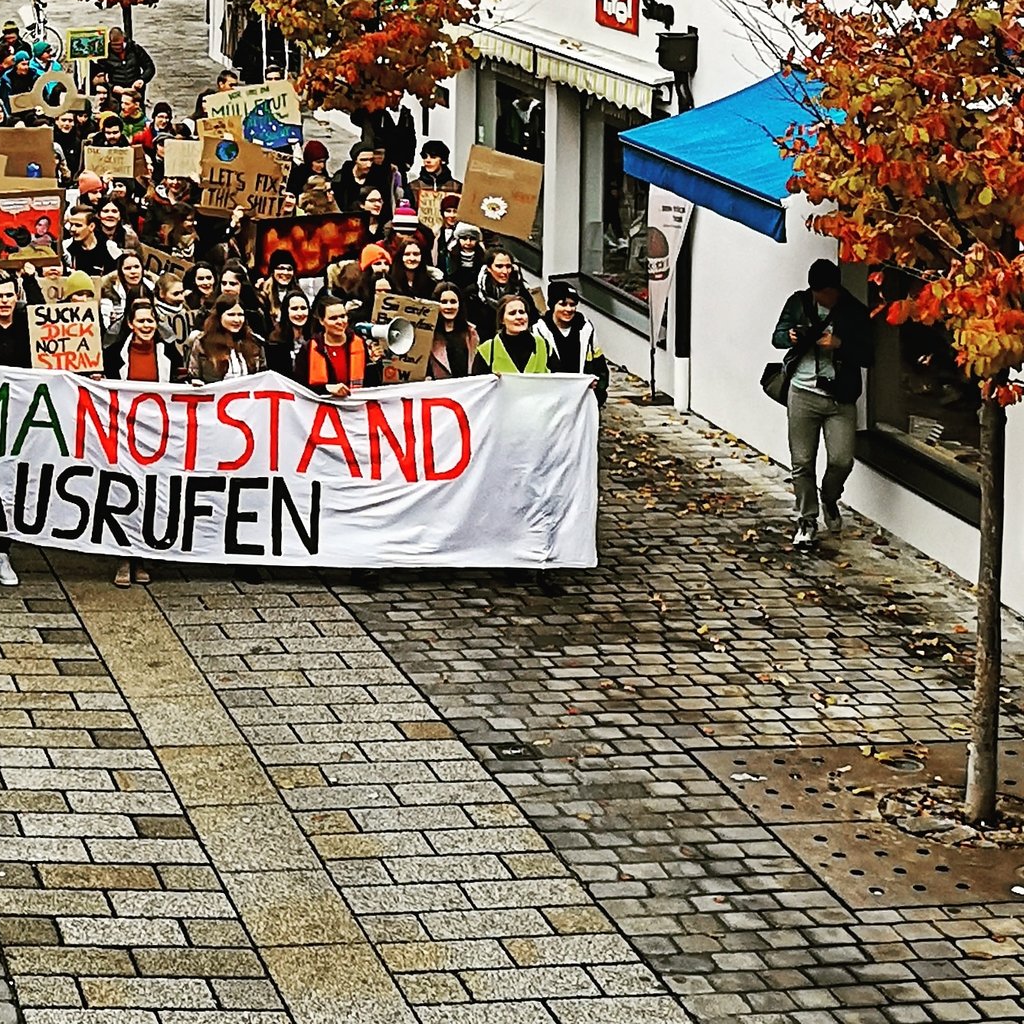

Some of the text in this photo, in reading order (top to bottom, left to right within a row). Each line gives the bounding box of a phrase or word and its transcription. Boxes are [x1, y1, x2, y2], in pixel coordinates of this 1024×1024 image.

[208, 167, 278, 193] LET'S FIX
[207, 187, 237, 210] THIS
[35, 305, 95, 326] SUCK A
[40, 322, 95, 341] DICK
[36, 337, 90, 354] NOT A
[37, 350, 101, 371] STRAW
